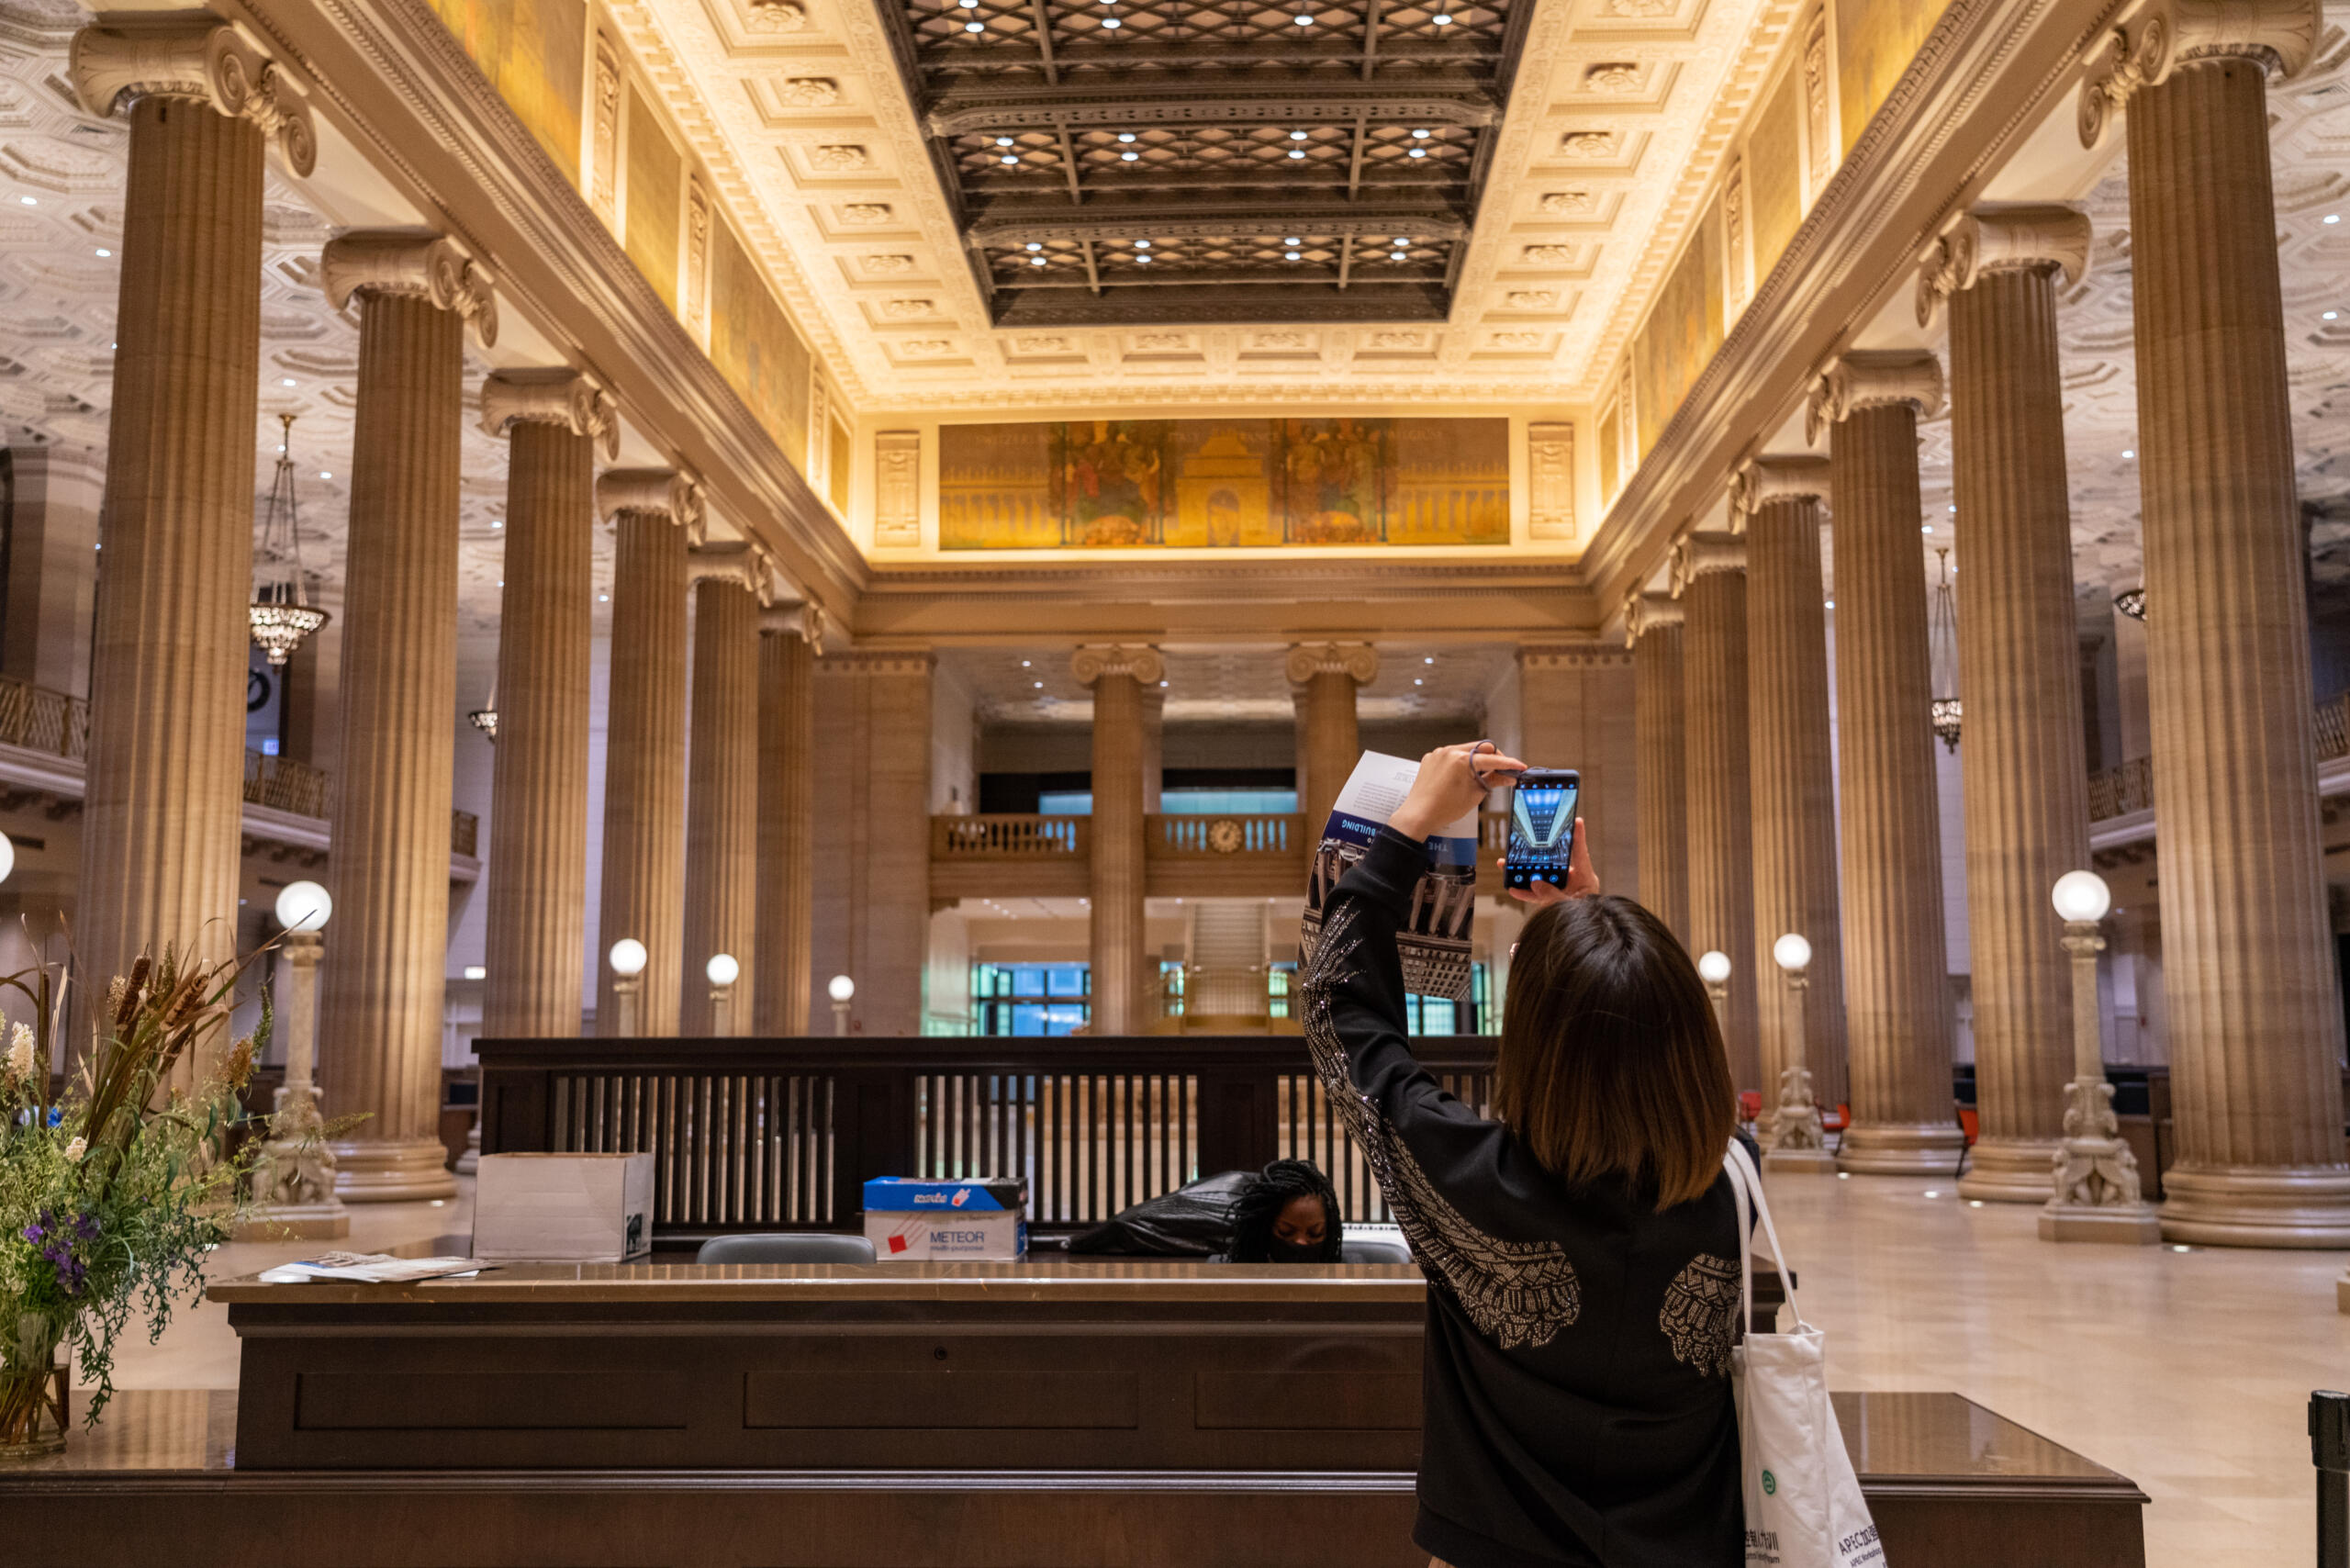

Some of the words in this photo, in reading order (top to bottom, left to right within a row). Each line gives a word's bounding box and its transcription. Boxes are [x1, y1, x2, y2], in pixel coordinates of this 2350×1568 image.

[1341, 819, 1376, 836] BUILDING
[1428, 842, 1449, 852] THE
[930, 1231, 984, 1243] METEOR
